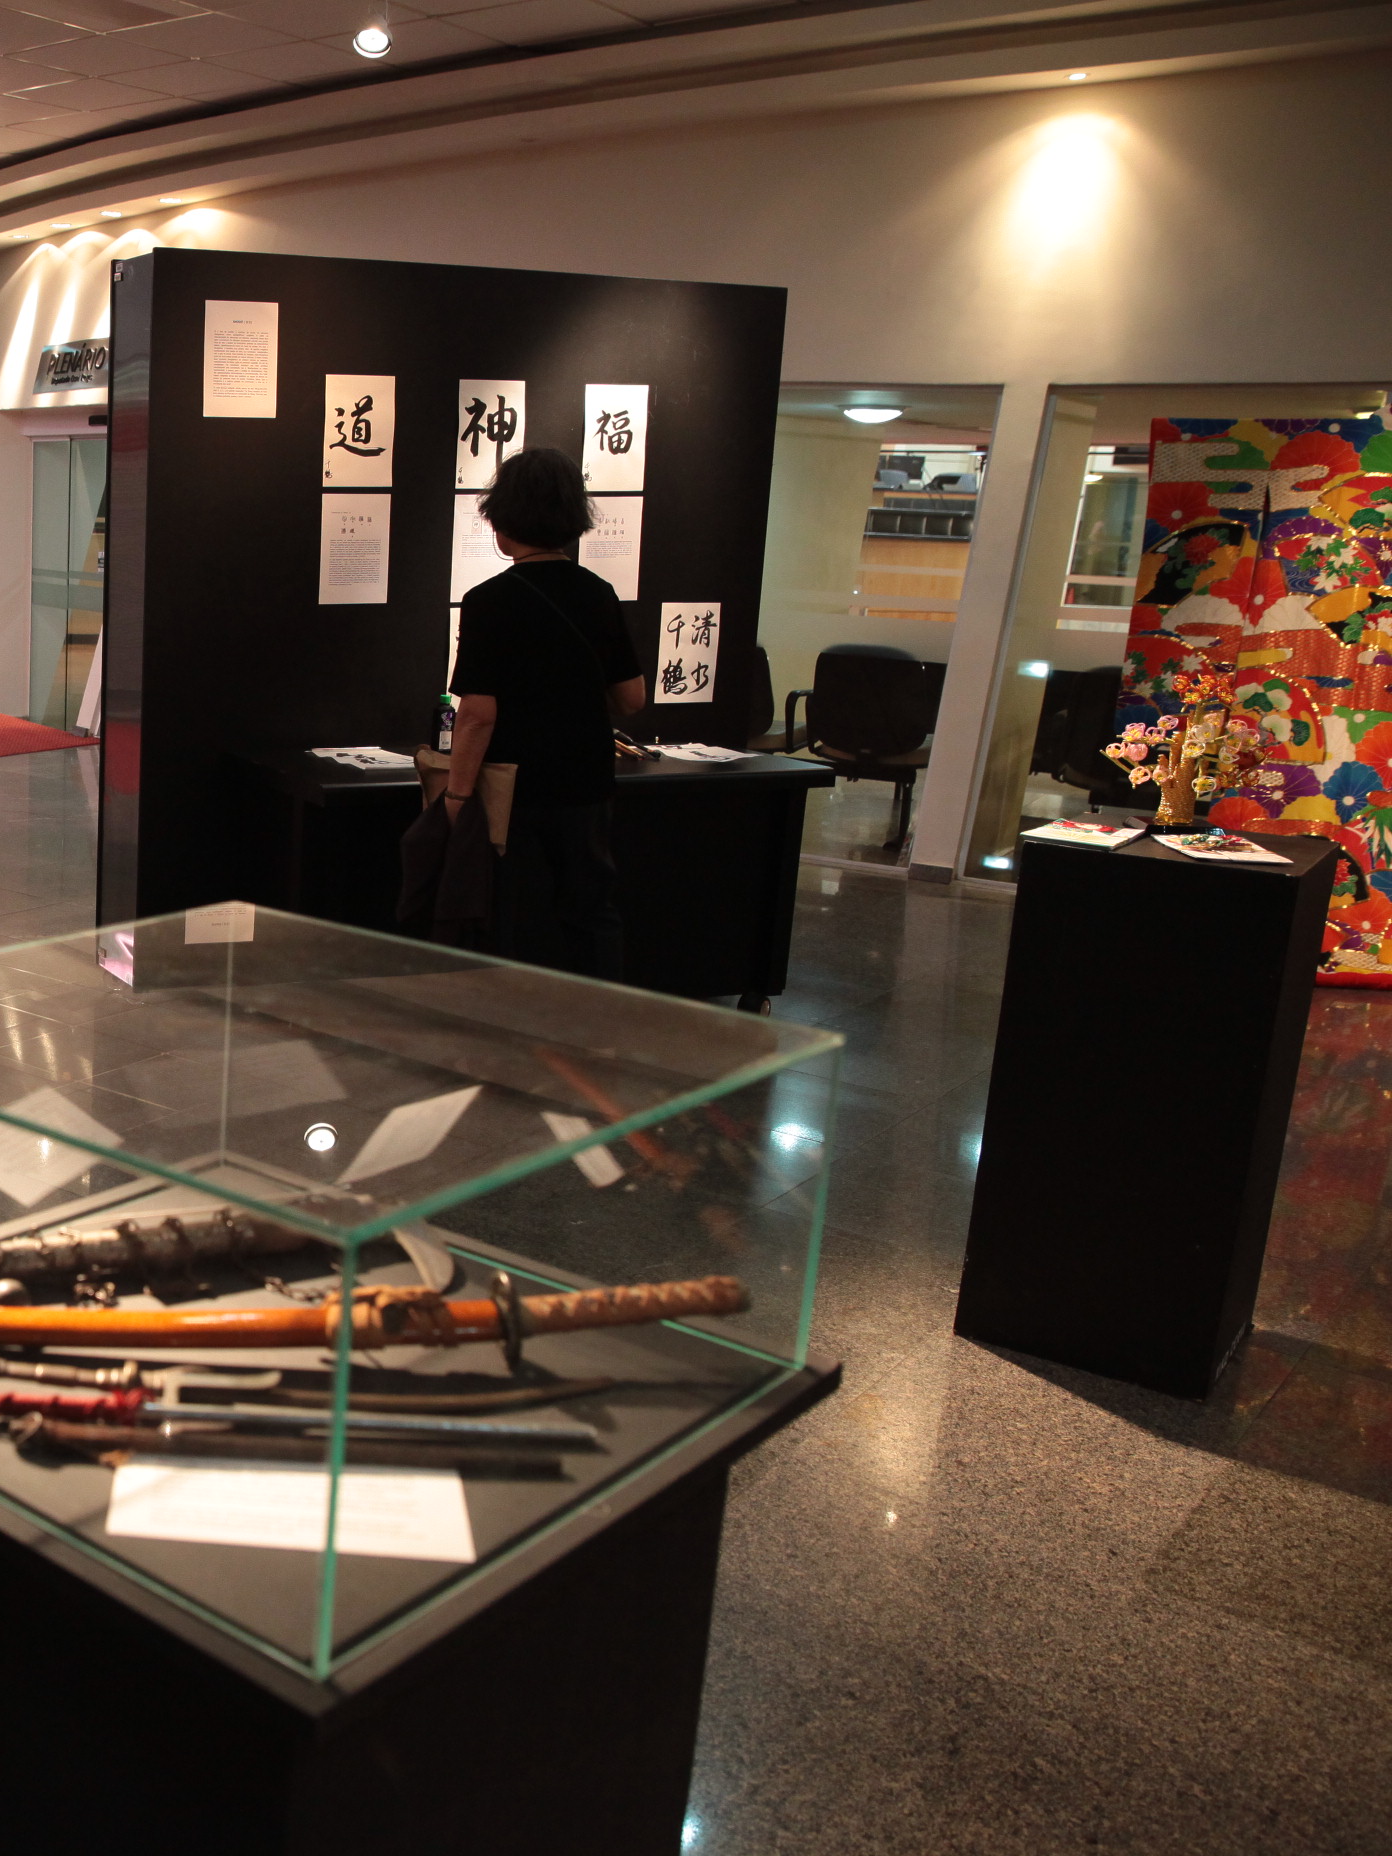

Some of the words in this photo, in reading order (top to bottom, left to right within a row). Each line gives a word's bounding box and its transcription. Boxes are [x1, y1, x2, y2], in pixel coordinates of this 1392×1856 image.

[47, 343, 106, 375] PLENÁRIO
[329, 395, 386, 457] 道
[461, 394, 518, 471] 神
[593, 410, 633, 456] 福
